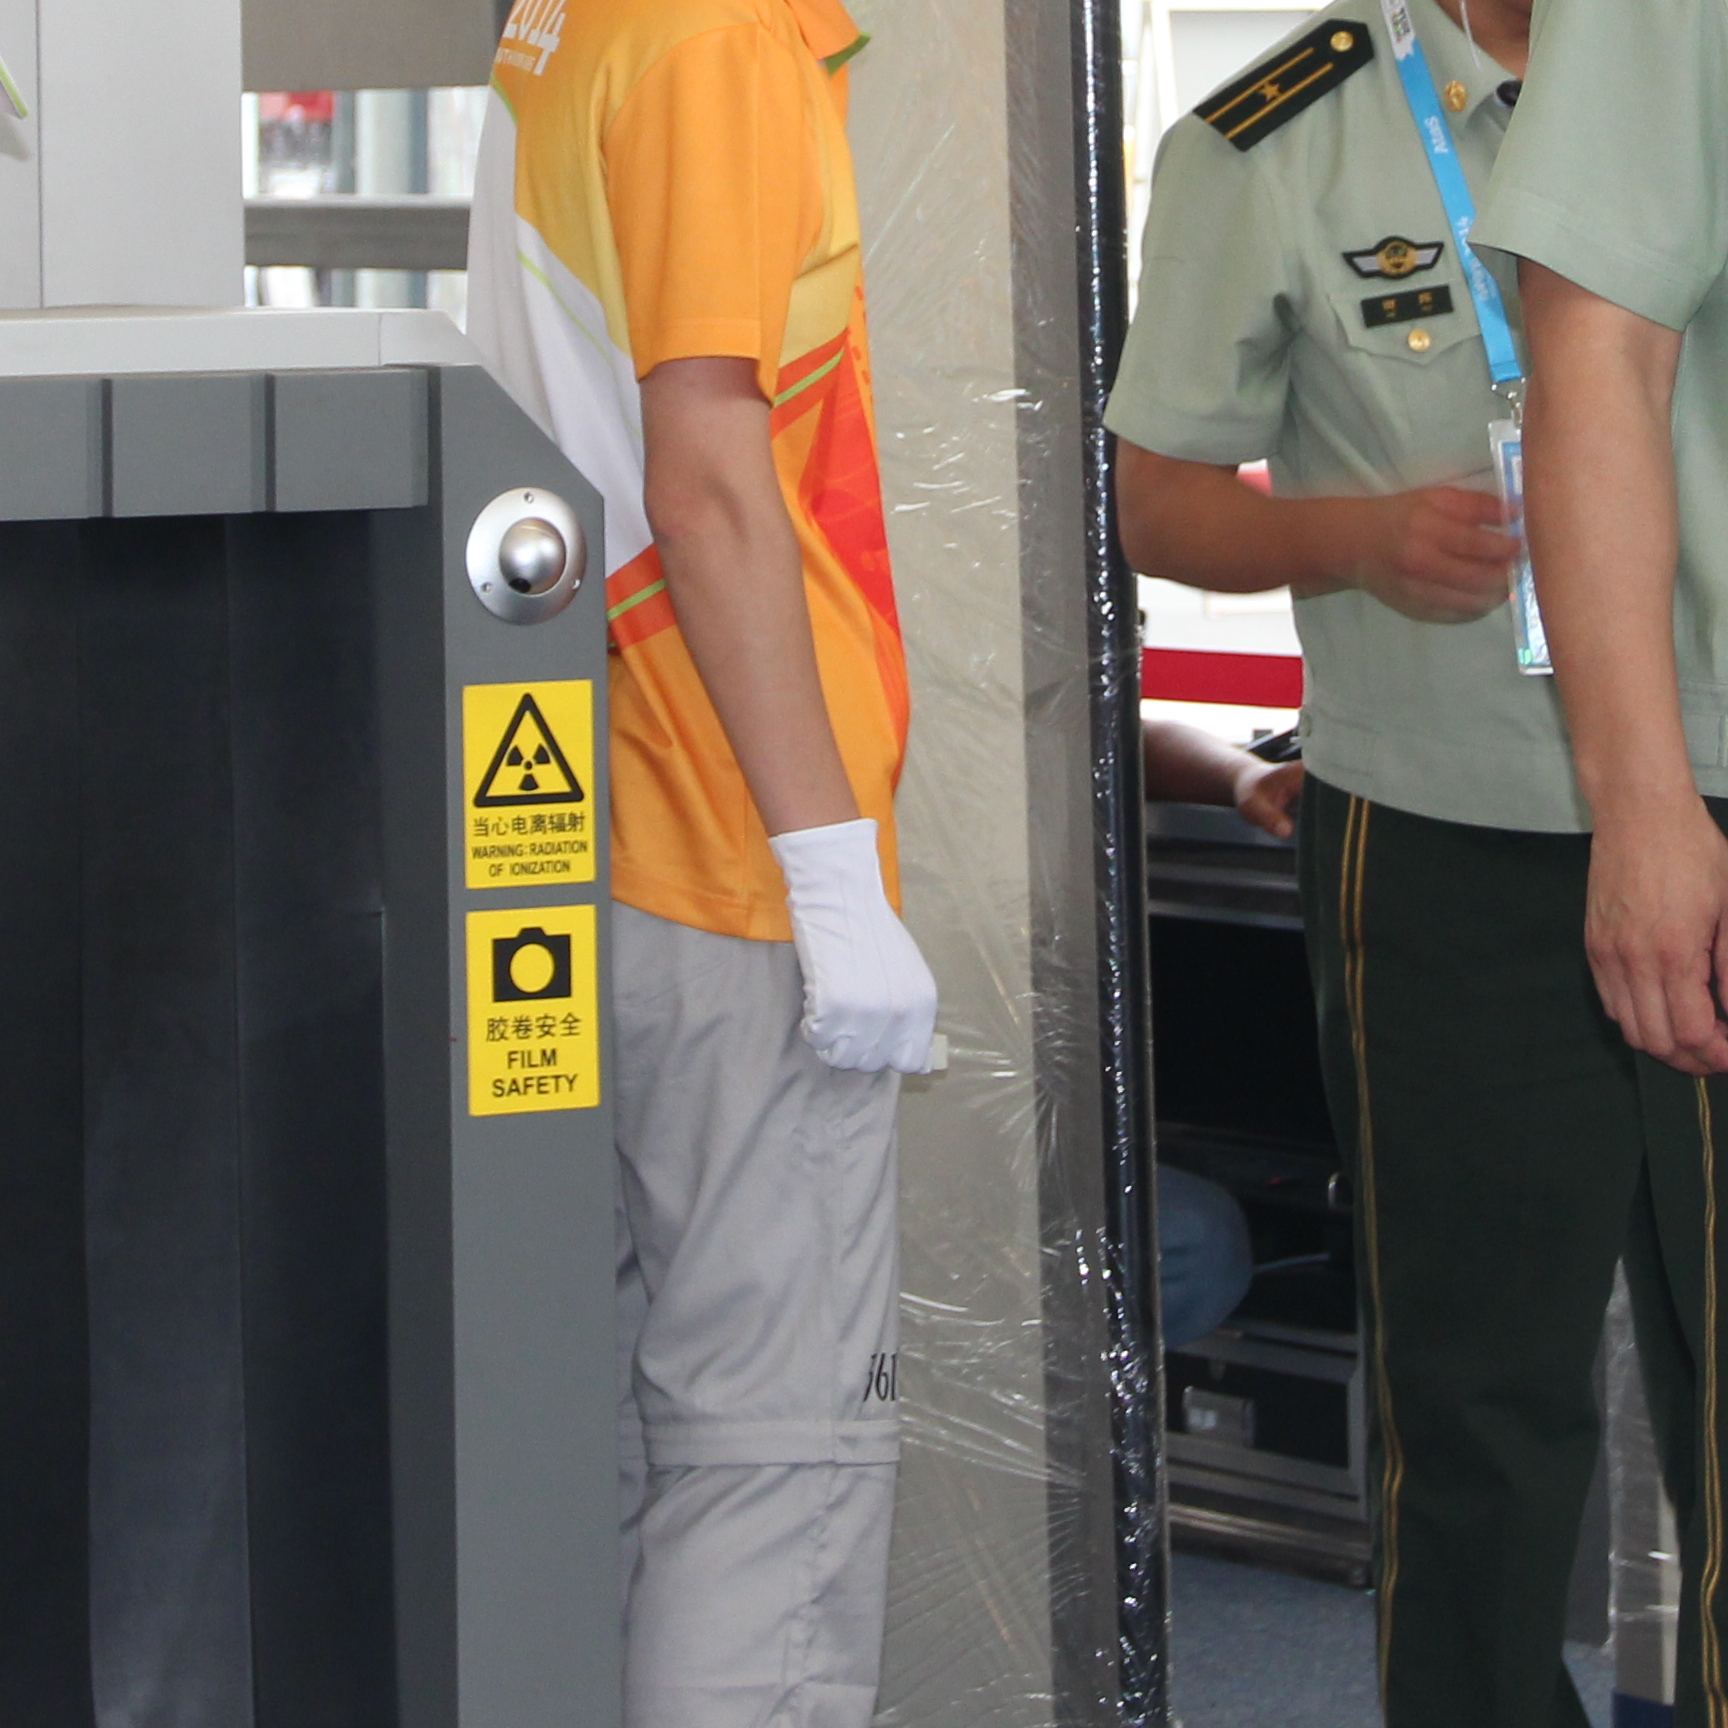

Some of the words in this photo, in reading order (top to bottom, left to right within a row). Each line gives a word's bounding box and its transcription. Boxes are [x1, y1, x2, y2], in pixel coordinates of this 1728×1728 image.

[473, 812, 585, 837] 当心电离辐射
[529, 840, 588, 855] RADIATION
[488, 863, 504, 877] OF
[510, 860, 570, 875] IONIZATION
[486, 1012, 582, 1042] 胶卷安全
[507, 1049, 557, 1069] FILM
[492, 1074, 578, 1098] SAFETY
